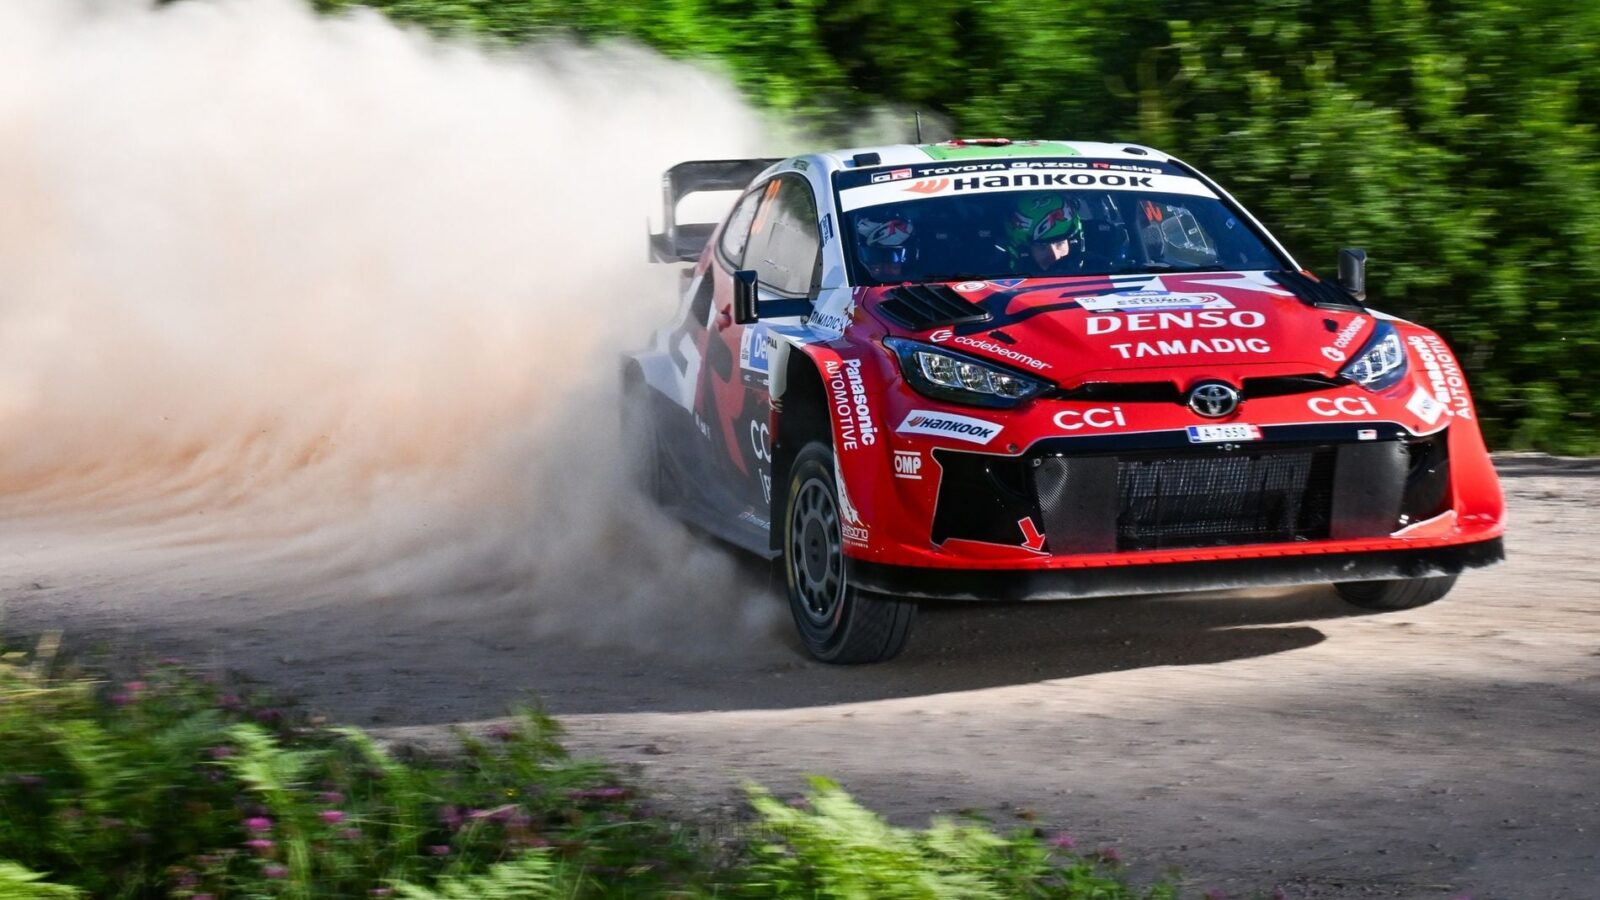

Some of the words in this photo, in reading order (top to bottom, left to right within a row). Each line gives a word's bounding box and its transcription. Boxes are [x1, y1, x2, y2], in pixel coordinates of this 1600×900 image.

[917, 163, 1006, 175] TOYOTA
[1011, 161, 1088, 170] GAZOO
[1092, 162, 1163, 174] Racing
[1086, 311, 1266, 336] DENSO
[954, 335, 1051, 370] codebeamer
[1110, 338, 1271, 359] TAMADIC
[824, 360, 858, 451] AUTOMOTIVE
[843, 358, 878, 447] Panasonic
[894, 455, 923, 475] OMP
